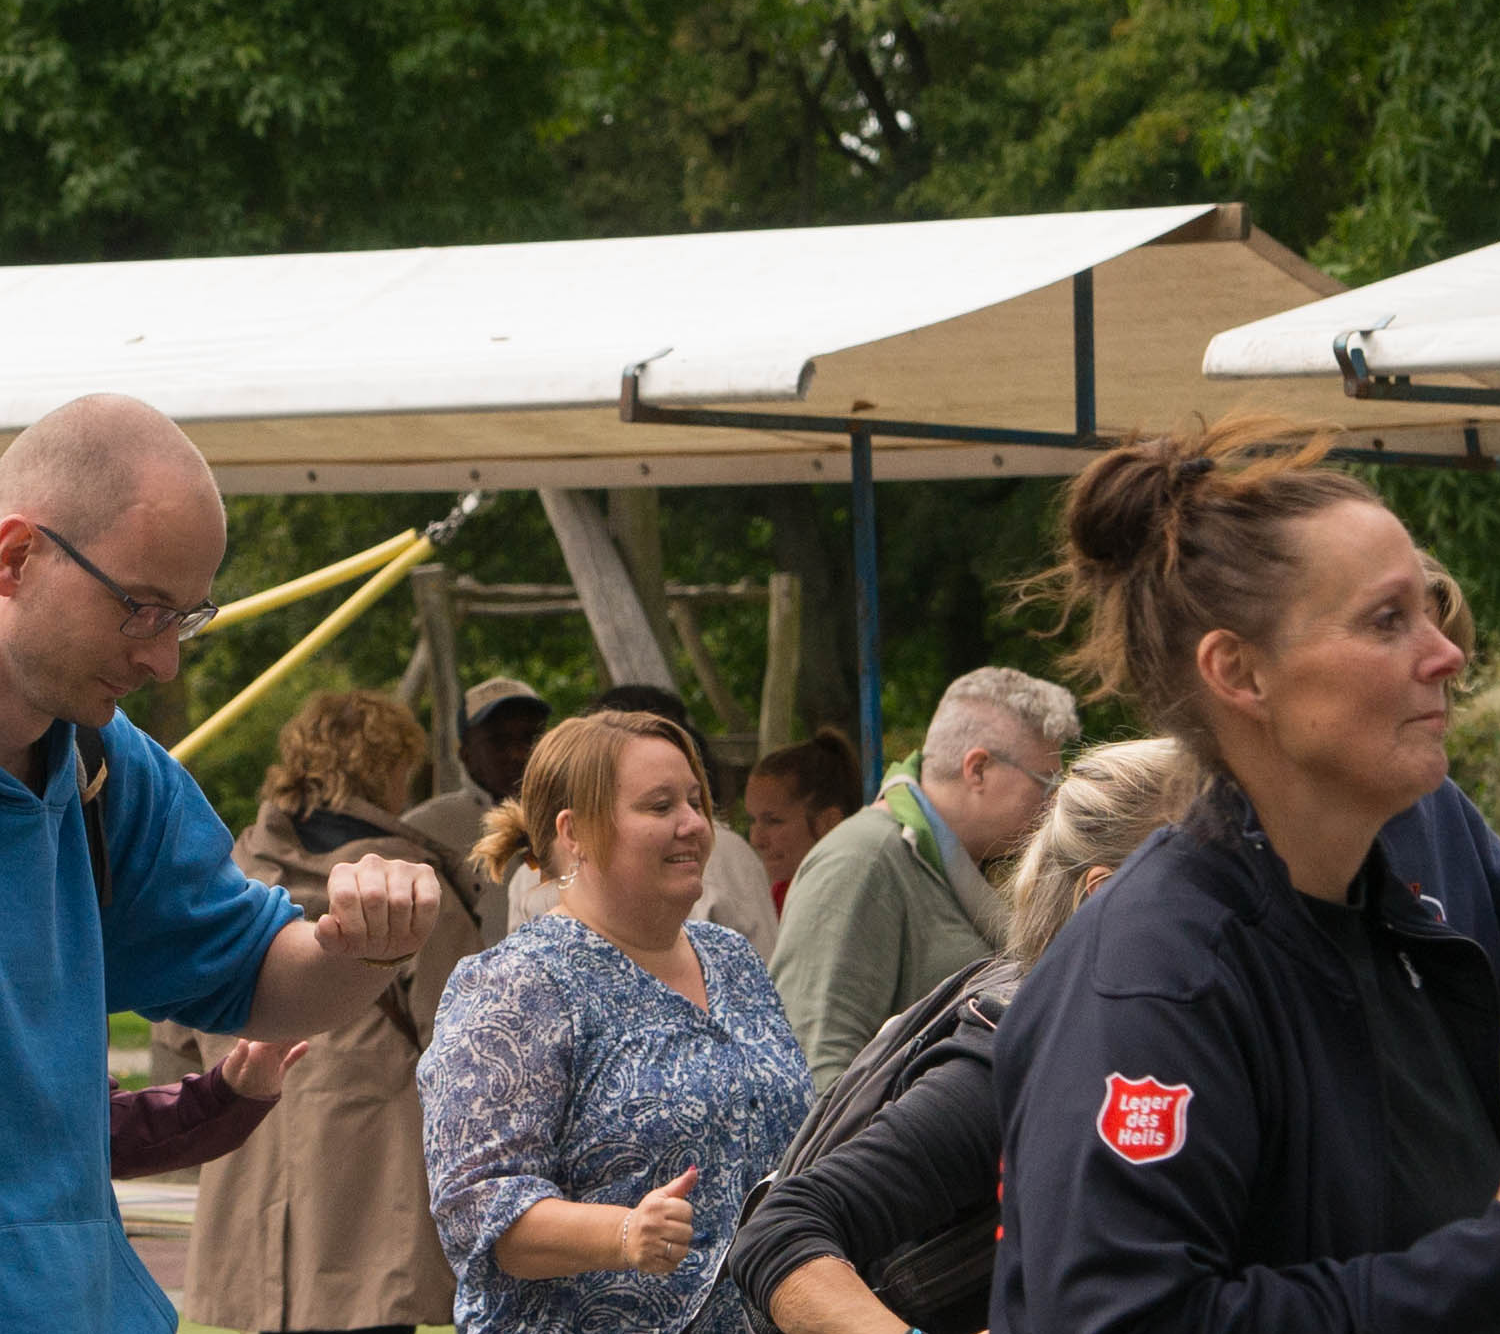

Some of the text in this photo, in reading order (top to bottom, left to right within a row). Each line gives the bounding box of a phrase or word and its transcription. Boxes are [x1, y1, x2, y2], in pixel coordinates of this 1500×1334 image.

[1119, 1094, 1173, 1114] Leger
[1126, 1112, 1160, 1128] des
[1117, 1127, 1165, 1146] Heils
